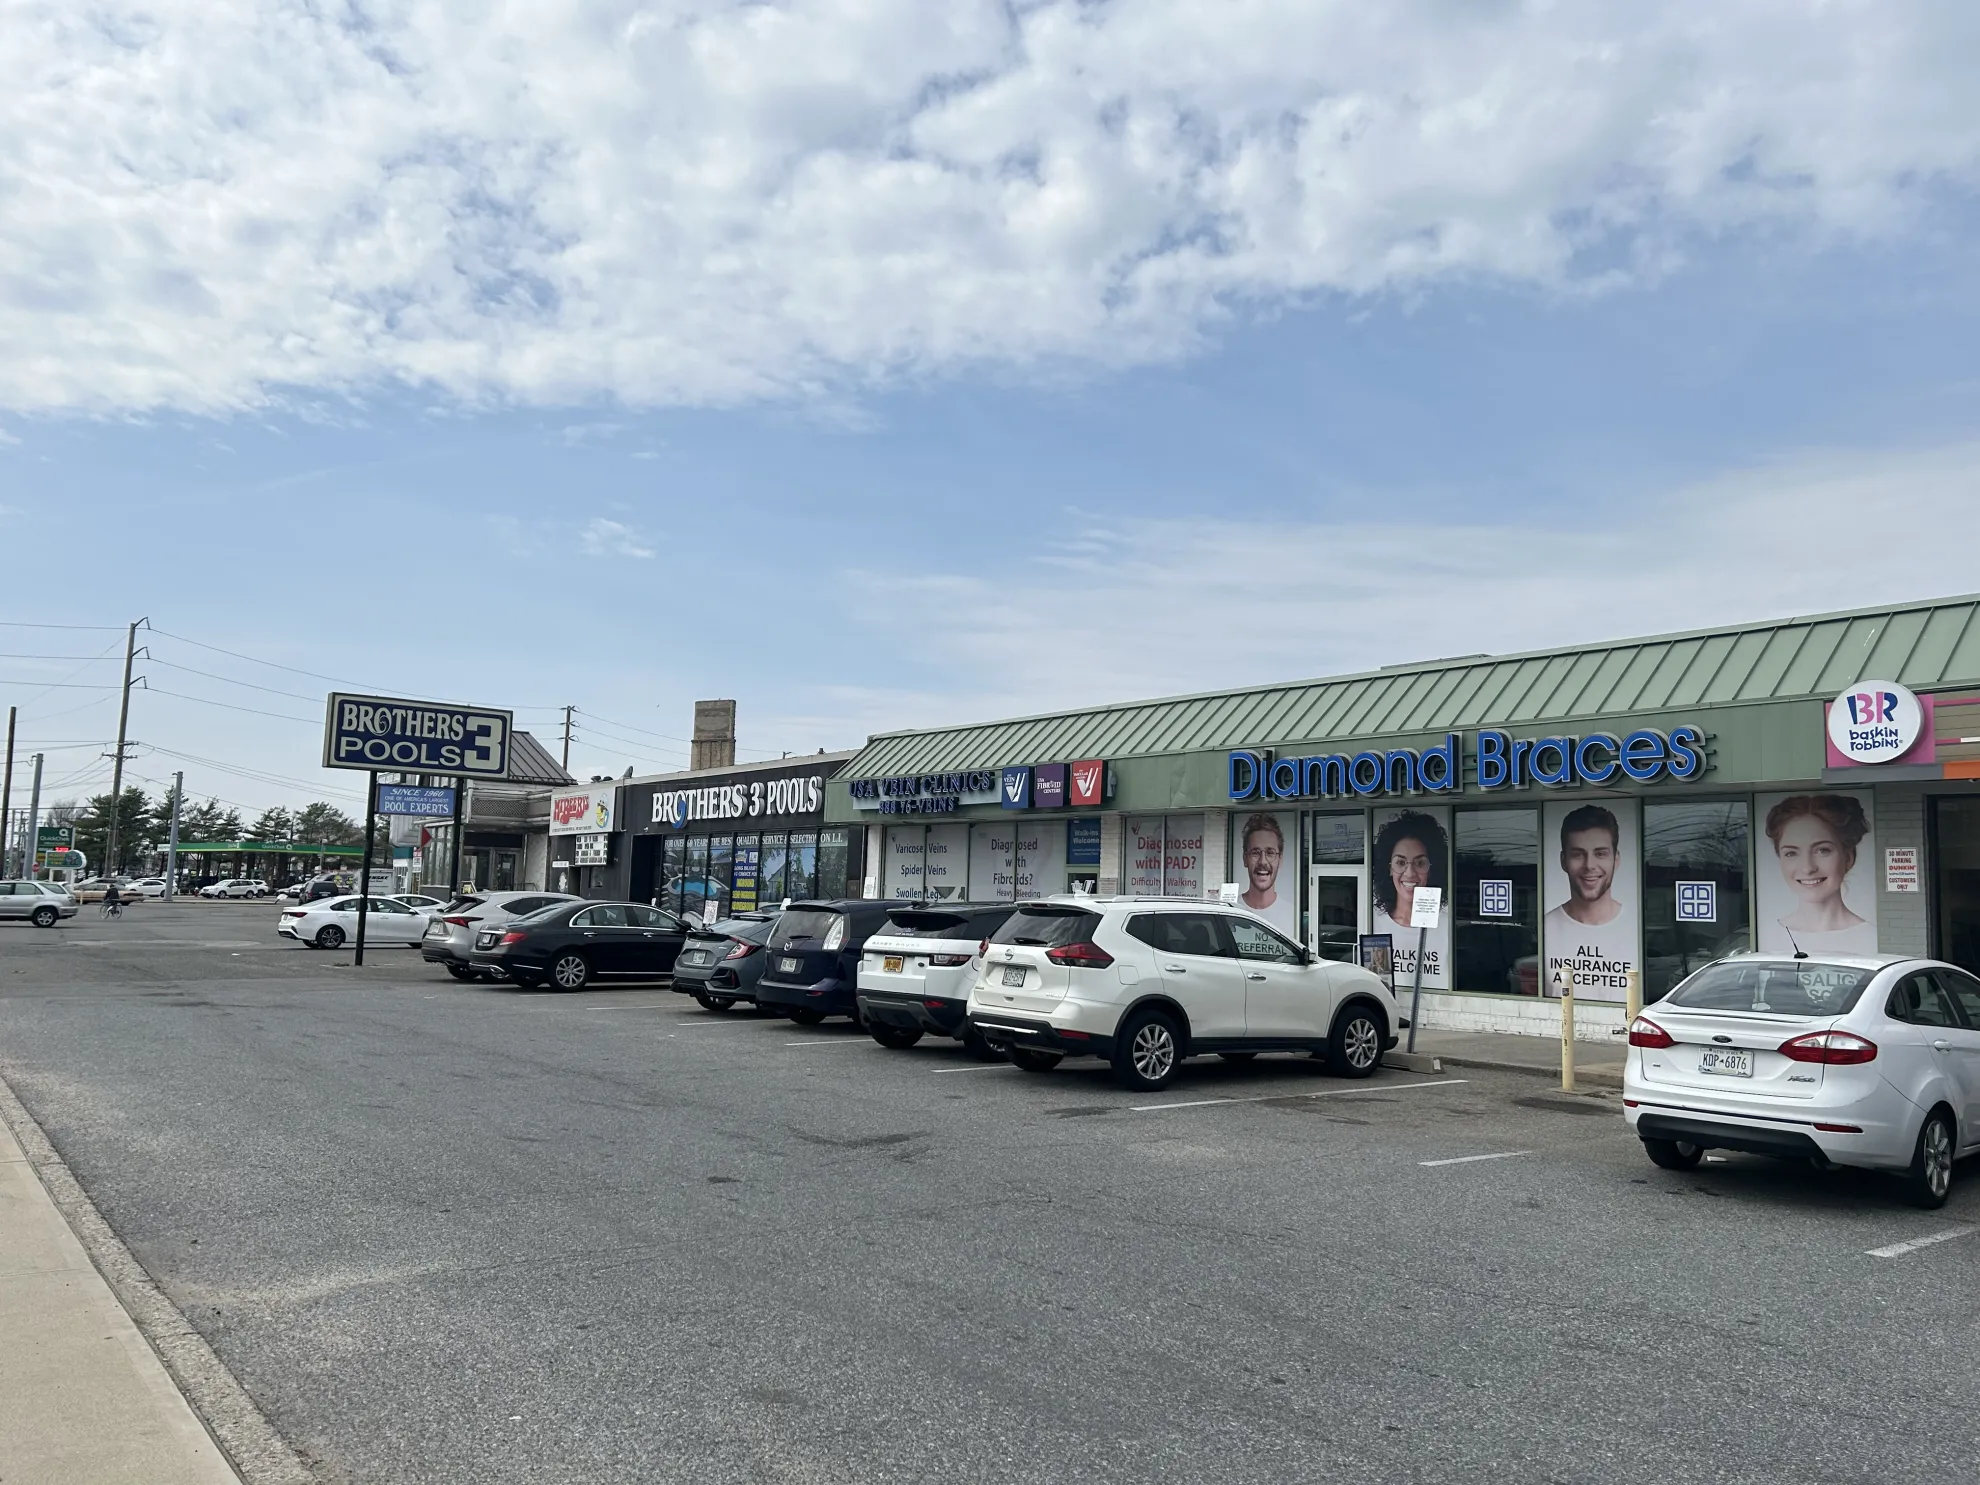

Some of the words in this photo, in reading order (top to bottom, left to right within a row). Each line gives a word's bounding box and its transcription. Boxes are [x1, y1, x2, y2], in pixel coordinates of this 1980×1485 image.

[1847, 691, 1898, 725] BR
[342, 703, 464, 741] BROTHERS
[1849, 727, 1898, 740] baskin
[463, 715, 503, 770] 3
[1850, 738, 1899, 751] robbins
[339, 736, 461, 767] POOLS
[1229, 734, 1455, 799] Diamond
[1477, 727, 1698, 787] Braces
[849, 779, 874, 797] USA
[878, 777, 917, 796] VEIN
[922, 771, 991, 793] CLINICS
[390, 788, 421, 797] SINCE
[384, 802, 407, 812] POOL
[410, 802, 449, 814] EXPERTS
[652, 784, 747, 828] BROTHERS
[749, 782, 762, 817] 3
[767, 776, 820, 814] POOLS
[900, 796, 954, 814] 76-VEINS
[665, 839, 674, 847] FOR
[711, 838, 720, 846] THE
[736, 836, 759, 847] QUALITY
[762, 835, 782, 845] SERVICE
[820, 833, 831, 843] ON
[1137, 835, 1202, 853] Diagnosed
[895, 843, 923, 854] Varicose
[928, 842, 947, 854] Veins
[1005, 856, 1026, 867] wth
[1136, 855, 1160, 869] with
[1165, 856, 1197, 870] PAD?
[900, 864, 923, 877] Spider
[927, 864, 946, 876] Veins
[1131, 877, 1161, 888] Difficulty
[1167, 877, 1197, 889] Walking
[896, 887, 923, 899] Swollen
[997, 888, 1012, 899] Heavy
[1016, 888, 1040, 900] Bleeding
[1254, 932, 1269, 942] NO
[1577, 945, 1604, 958] ALL
[1392, 962, 1441, 975] ELCME
[1550, 957, 1632, 974] INSURANCE
[1553, 971, 1628, 988] ACEPTED
